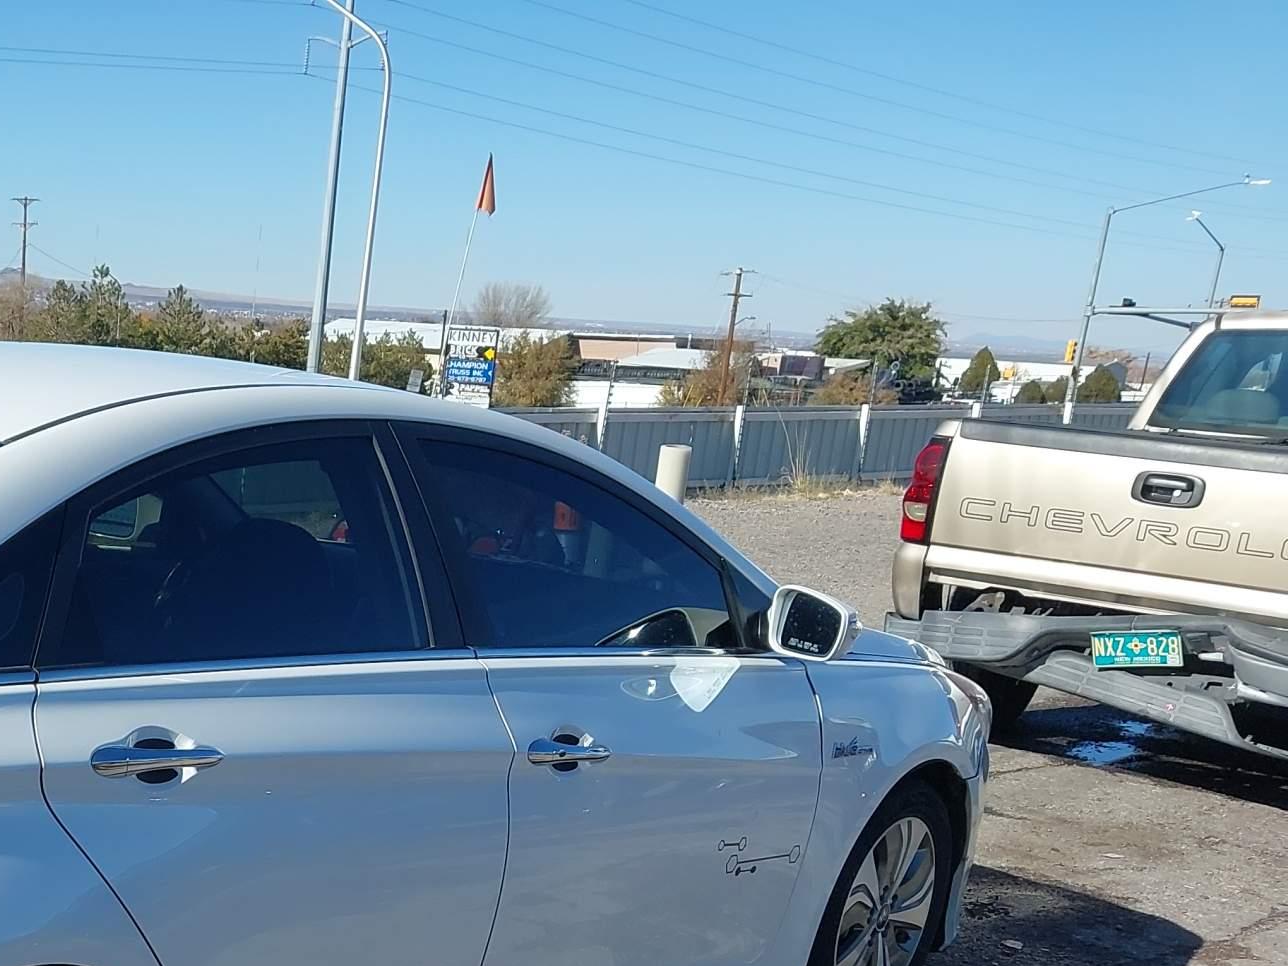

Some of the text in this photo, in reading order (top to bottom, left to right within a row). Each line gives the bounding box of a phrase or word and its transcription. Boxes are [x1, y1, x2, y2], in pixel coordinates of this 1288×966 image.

[450, 331, 495, 343] KINNEY
[960, 496, 1288, 561] CHEVROL
[1094, 637, 1126, 657] NXZ
